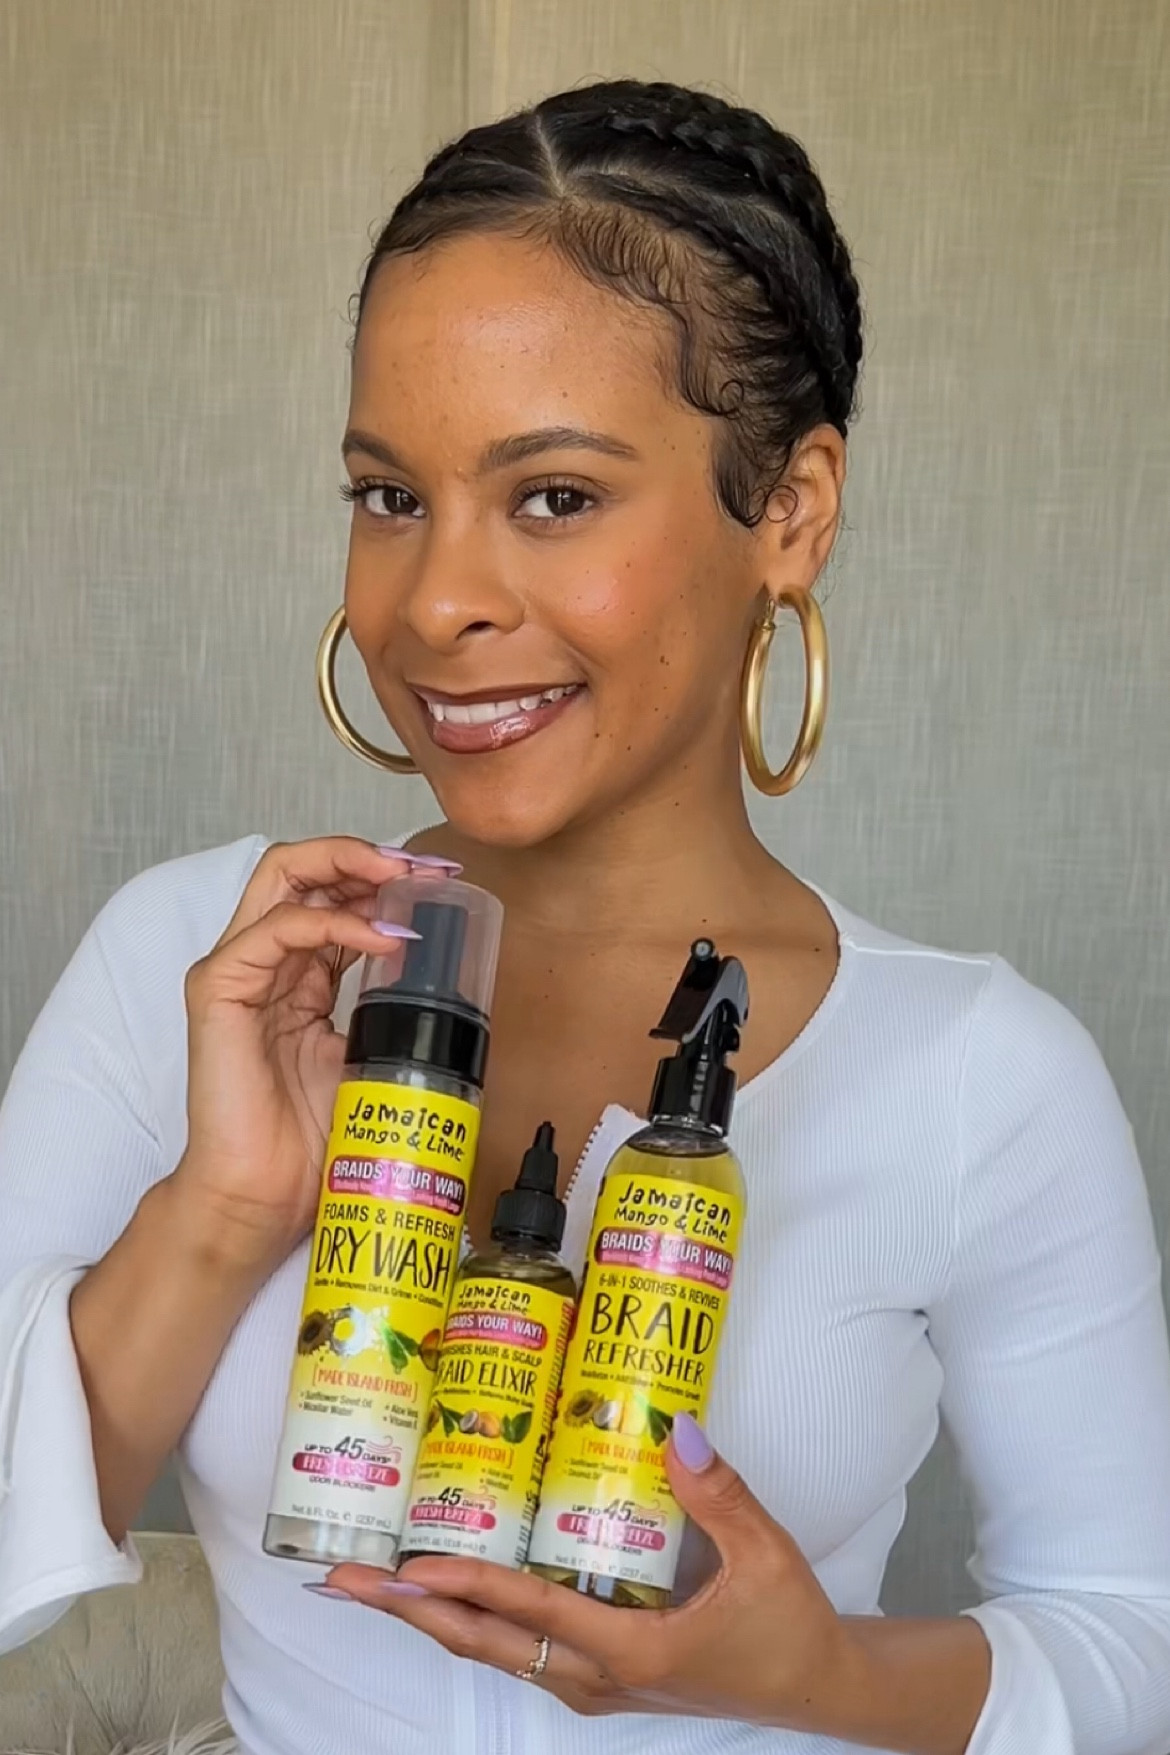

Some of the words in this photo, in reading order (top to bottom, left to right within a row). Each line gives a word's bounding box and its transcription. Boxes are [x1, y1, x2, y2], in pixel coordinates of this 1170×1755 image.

[349, 1097, 467, 1142] Jamaican
[344, 1124, 400, 1144] Mango
[407, 1134, 421, 1151] &
[426, 1136, 465, 1162] Lime
[333, 1161, 383, 1180] BRAIDS
[391, 1169, 431, 1190] YOUR
[435, 1175, 463, 1201] WAY!
[619, 1181, 731, 1226] Jamaican
[323, 1203, 369, 1221] FOAMS
[375, 1209, 387, 1225] &
[394, 1213, 456, 1241] REFRESH
[613, 1206, 668, 1226] Mango
[675, 1214, 687, 1233] &
[692, 1217, 728, 1244] Lime
[315, 1227, 371, 1274] DRY
[374, 1231, 452, 1297] WASH
[601, 1232, 654, 1252] BRAIDS
[659, 1239, 701, 1263] YOUR
[704, 1248, 733, 1275] WAY!
[459, 1284, 531, 1306] Jamaican
[490, 1300, 496, 1310] &
[628, 1276, 677, 1298] SOOTHES
[678, 1285, 687, 1299] &
[689, 1288, 721, 1310] REVIVES
[477, 1314, 509, 1330] YOUR
[512, 1320, 543, 1340] WAY!
[590, 1292, 714, 1355] BRAID
[474, 1345, 500, 1358] HAIR
[501, 1347, 511, 1360] &
[512, 1348, 543, 1367] SCALP
[583, 1340, 705, 1387] REFRESHER
[306, 1390, 338, 1402] Sunflower
[346, 1371, 382, 1391] ISLAND
[479, 1362, 538, 1397] ELIXIR
[319, 1445, 332, 1453] TO
[334, 1436, 366, 1459] 45
[438, 1486, 464, 1506] 45
[572, 1504, 586, 1512] UP
[588, 1506, 601, 1515] TO
[603, 1498, 635, 1522] 45
